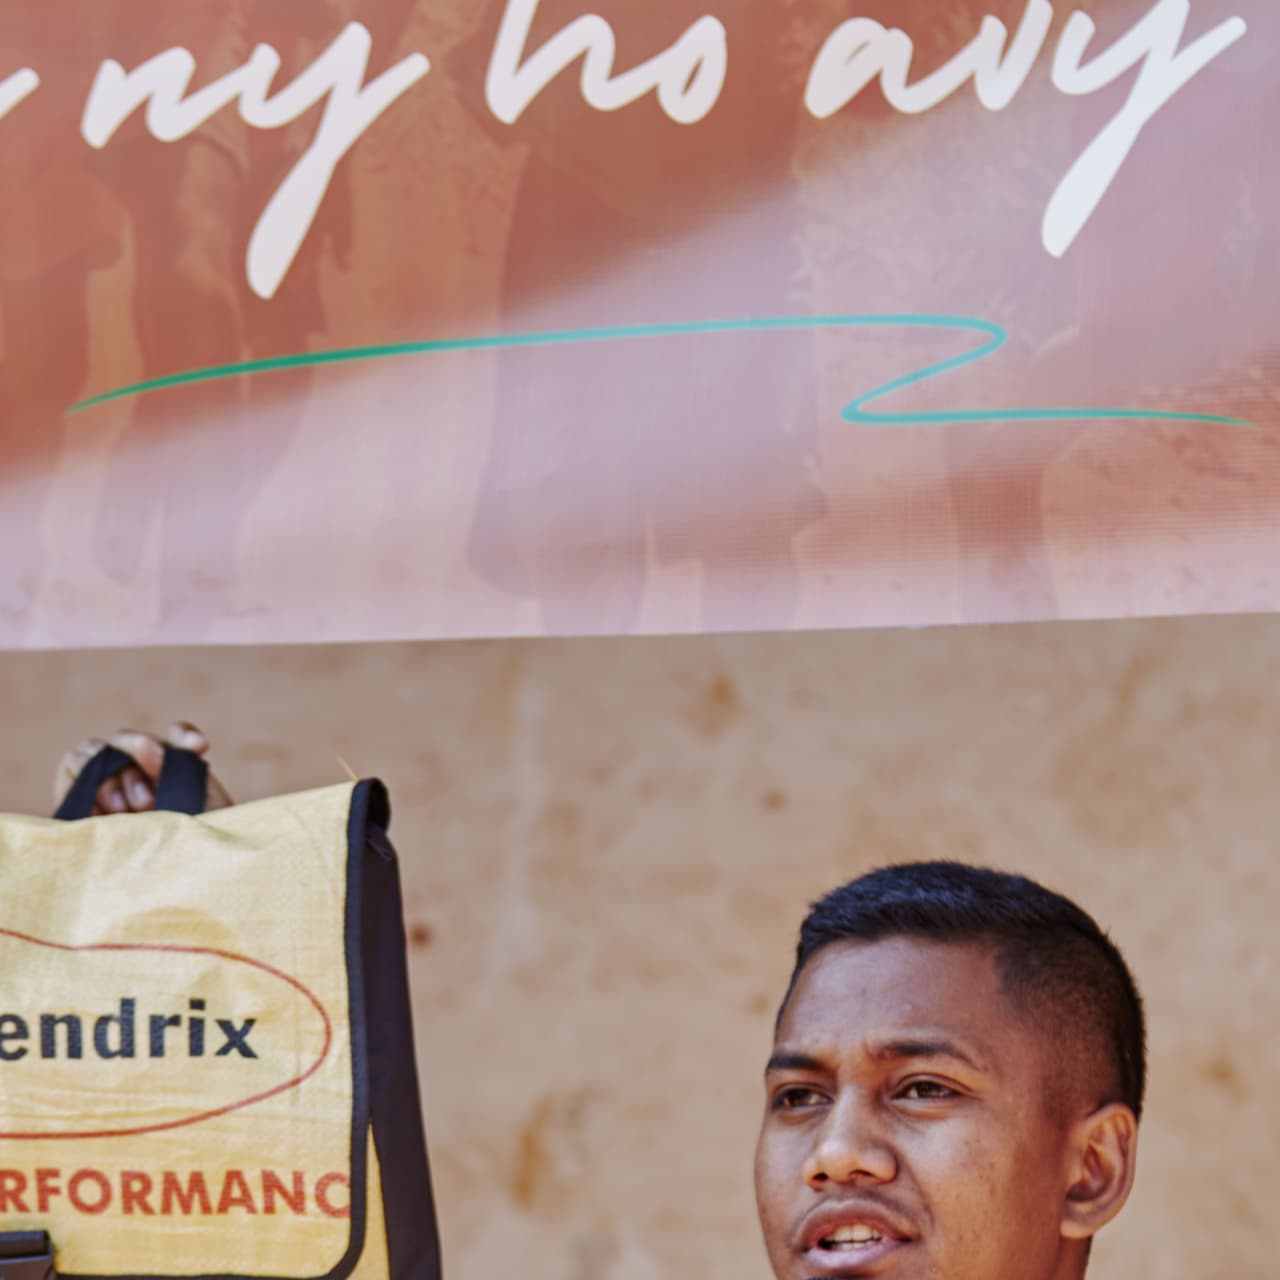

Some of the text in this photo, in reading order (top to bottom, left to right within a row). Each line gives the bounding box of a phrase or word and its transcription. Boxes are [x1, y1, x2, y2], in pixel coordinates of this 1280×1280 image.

[81, 21, 431, 300] ny
[486, 0, 728, 125] ho
[804, 0, 1248, 258] avy
